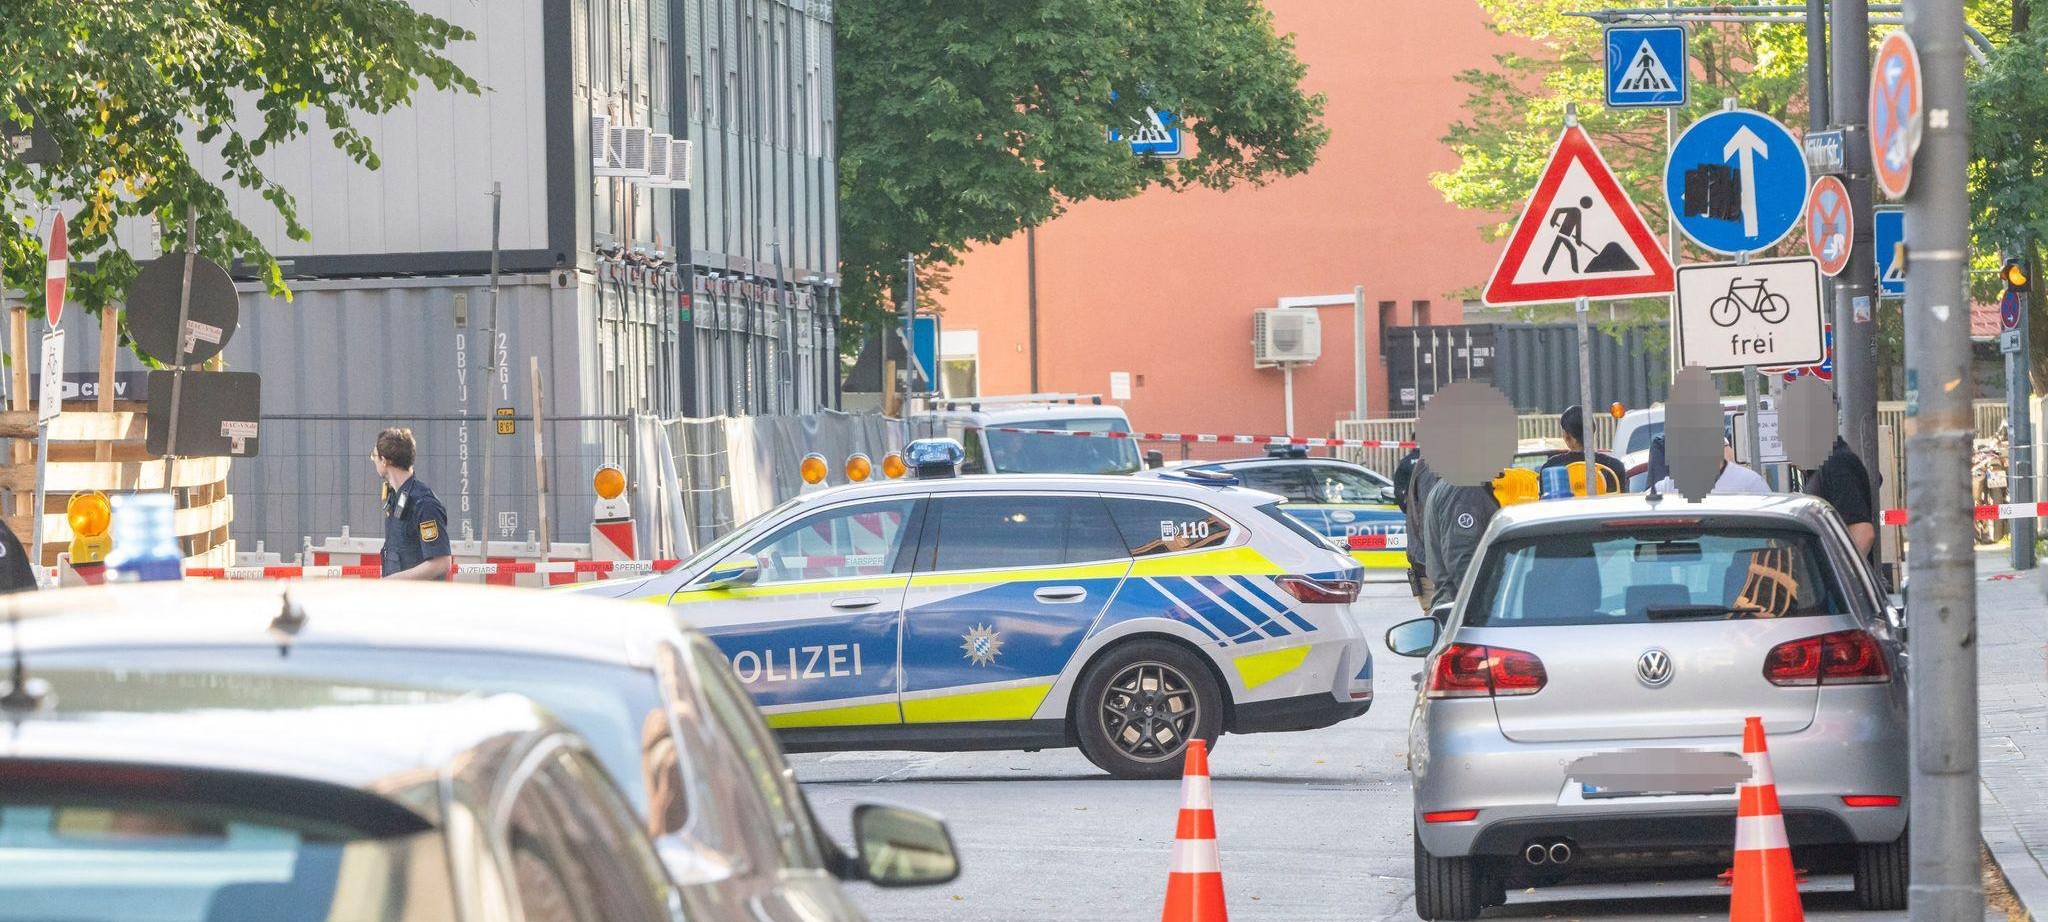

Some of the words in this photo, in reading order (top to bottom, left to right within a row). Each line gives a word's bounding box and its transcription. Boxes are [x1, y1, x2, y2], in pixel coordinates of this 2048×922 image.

[1731, 331, 1774, 355] frei
[456, 334, 467, 402] DBVU
[498, 332, 508, 401] 22G1
[1180, 521, 1209, 539] 110
